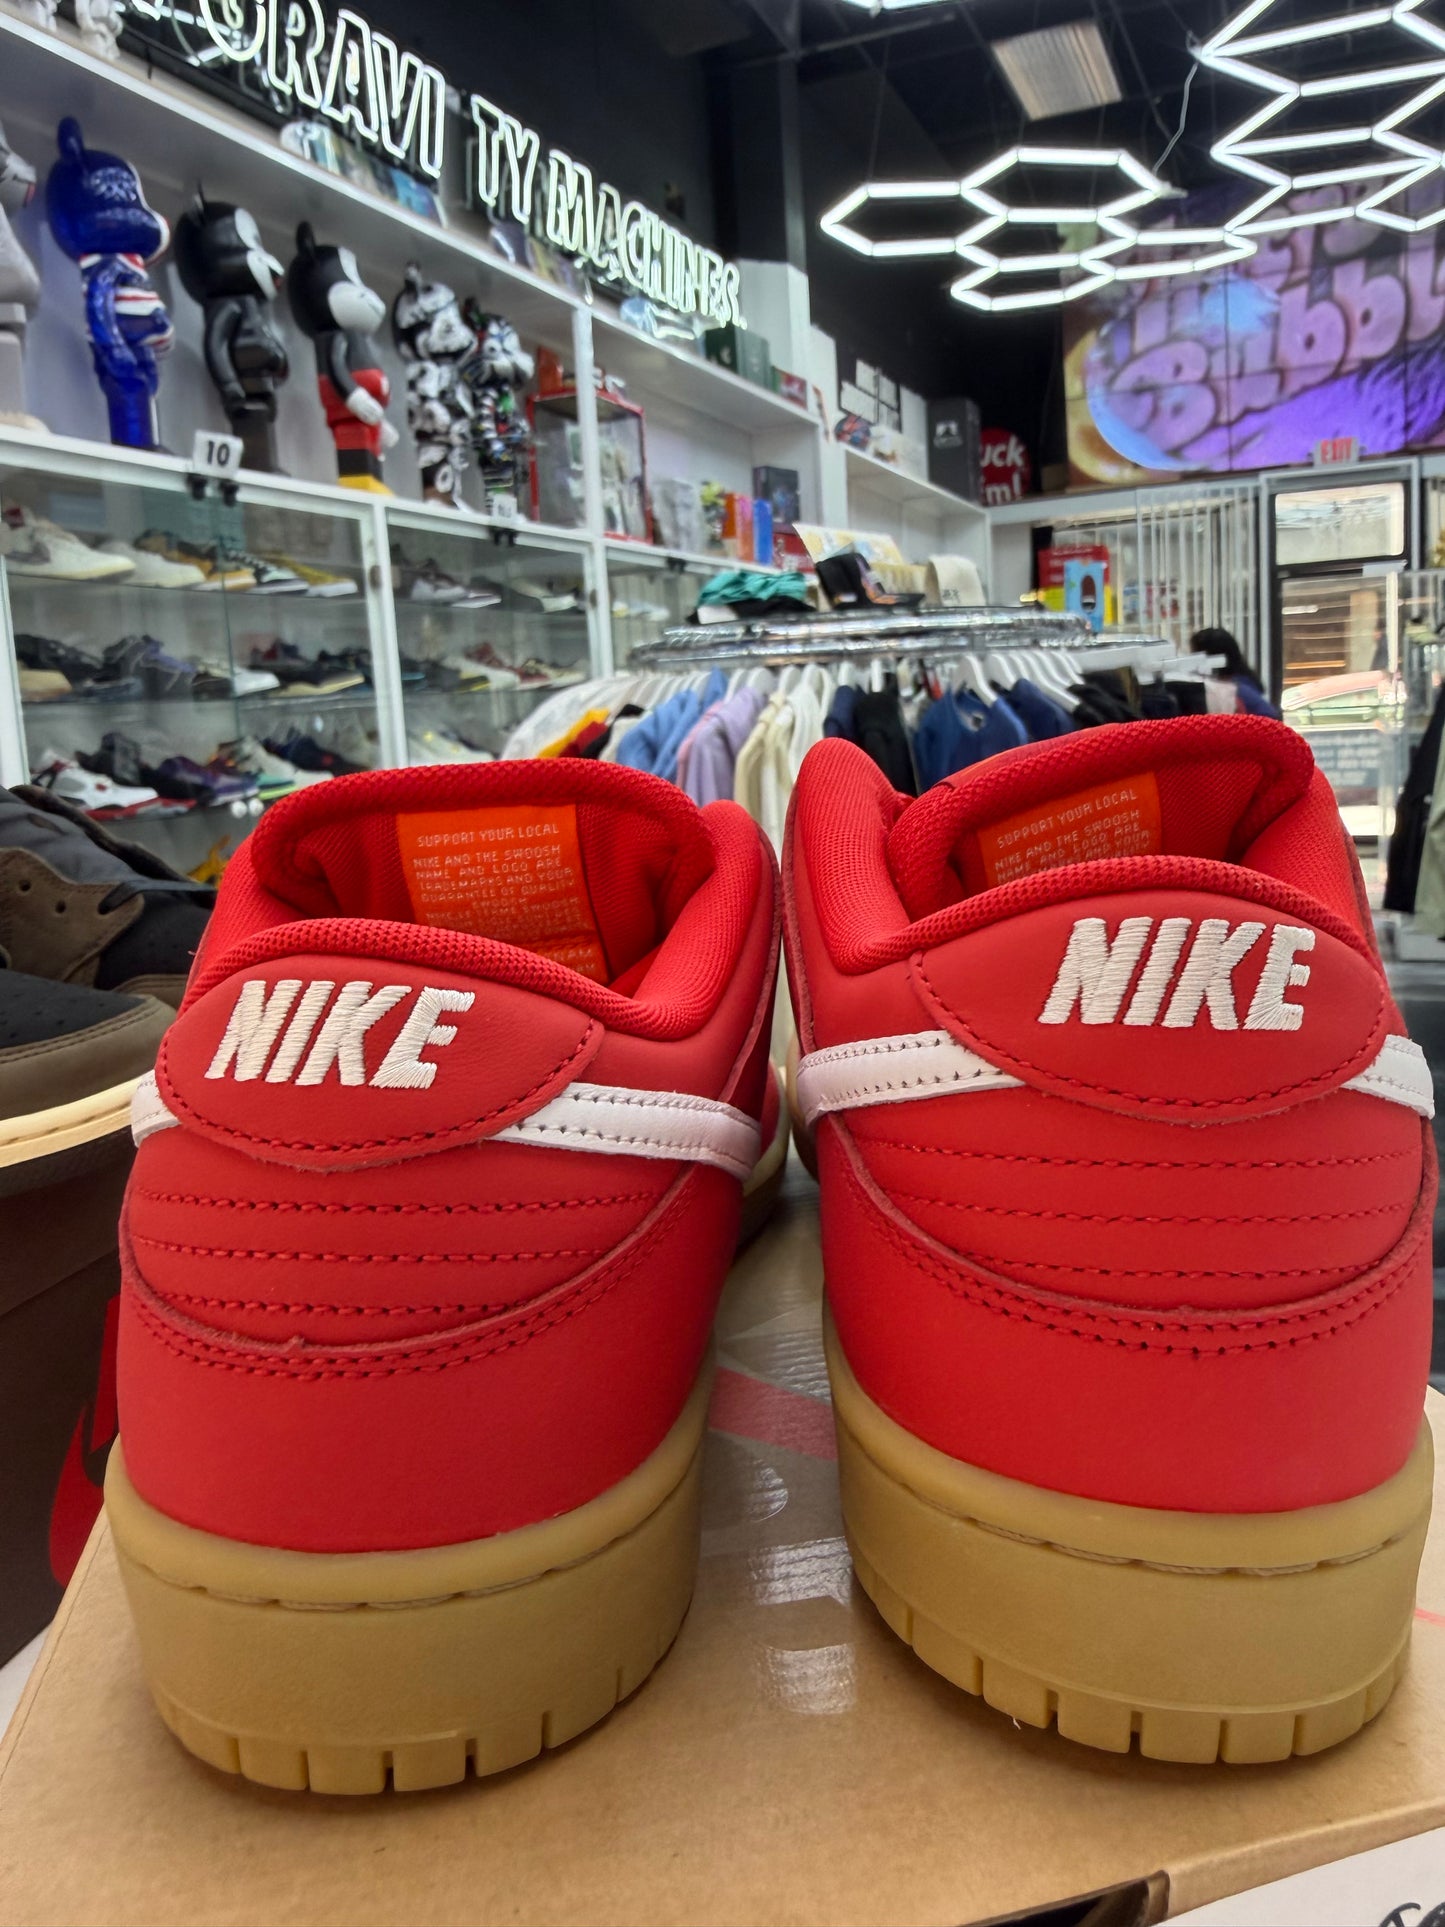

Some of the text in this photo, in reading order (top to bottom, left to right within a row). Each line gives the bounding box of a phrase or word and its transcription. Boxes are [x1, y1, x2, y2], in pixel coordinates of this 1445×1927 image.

[207, 440, 231, 467] 10
[1320, 436, 1354, 465] EXIT
[996, 788, 1138, 849] SUPPORT YOUR LOCAL
[416, 823, 560, 848] SUPPORT YOUR LOCAL
[994, 852, 1022, 871] NIKE
[1026, 840, 1052, 859] AND
[1056, 830, 1079, 847] THE
[1083, 809, 1140, 836] SWOOSH
[412, 845, 561, 869] NIKE AND THE SWOOSH
[415, 868, 450, 881] NAME
[459, 865, 485, 878] AND
[1037, 916, 1316, 1031] NIKE
[204, 979, 475, 1089] NIKE
